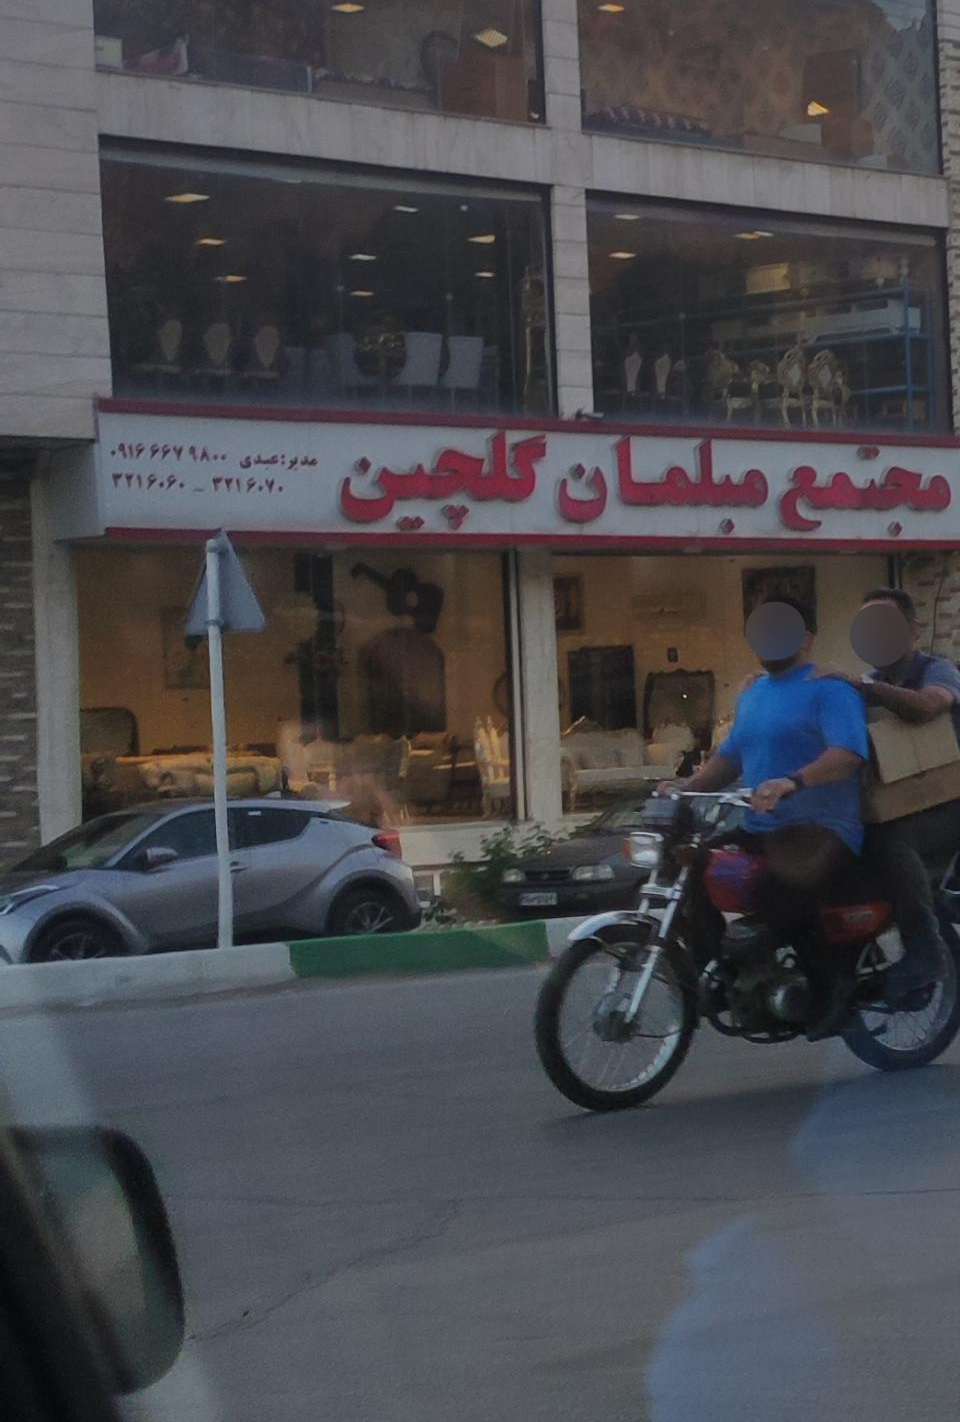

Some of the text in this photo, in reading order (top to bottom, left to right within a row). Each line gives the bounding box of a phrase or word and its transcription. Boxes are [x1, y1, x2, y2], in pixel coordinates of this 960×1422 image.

[338, 429, 952, 536] مجتمع مبلمان گلچین
